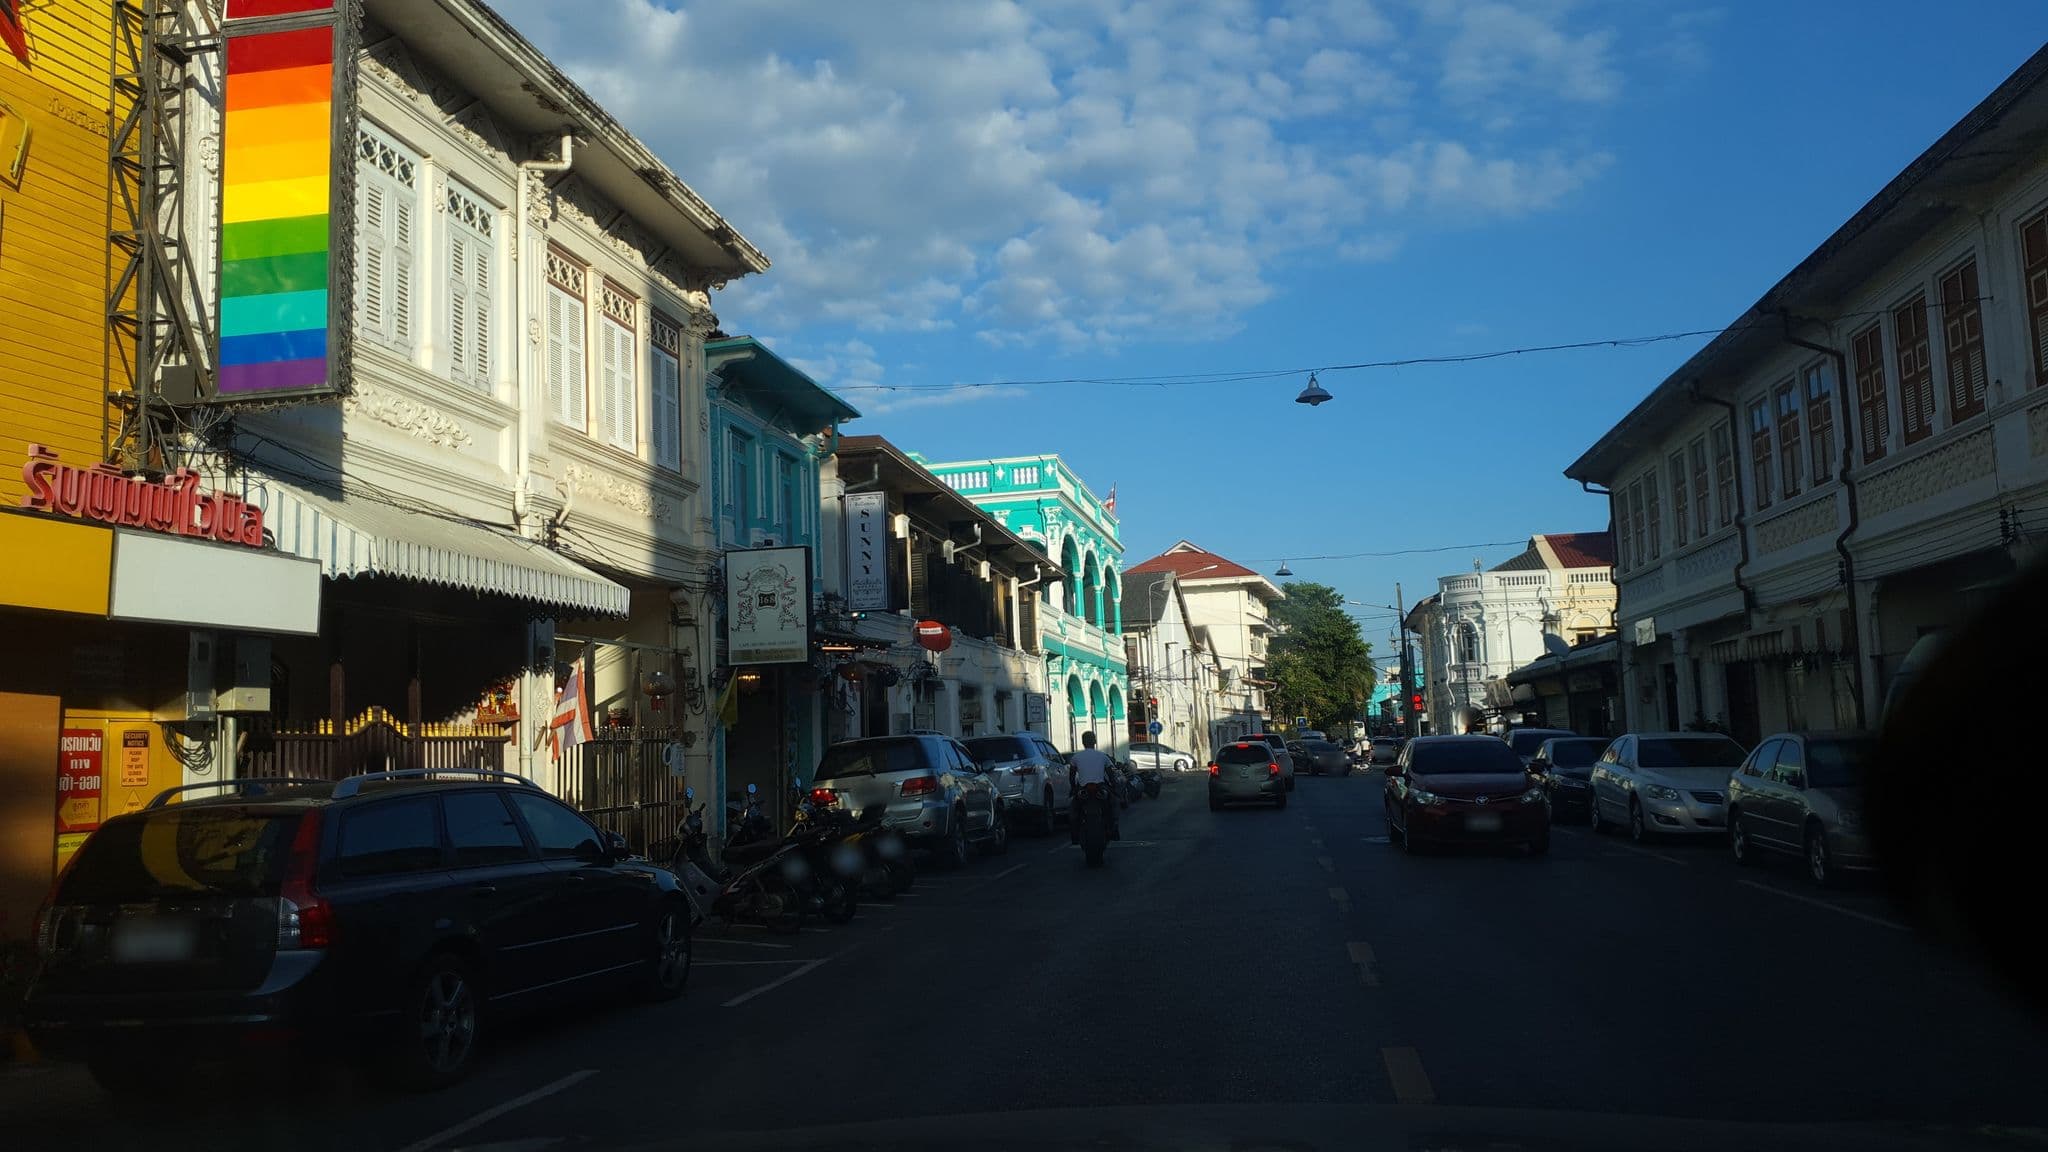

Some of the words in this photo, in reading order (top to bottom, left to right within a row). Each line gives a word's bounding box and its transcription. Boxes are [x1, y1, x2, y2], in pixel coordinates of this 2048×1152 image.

[21, 443, 263, 547] รับพิมพ์ไวนิล
[861, 509, 872, 575] SUNNY
[70, 758, 91, 769] ทาง
